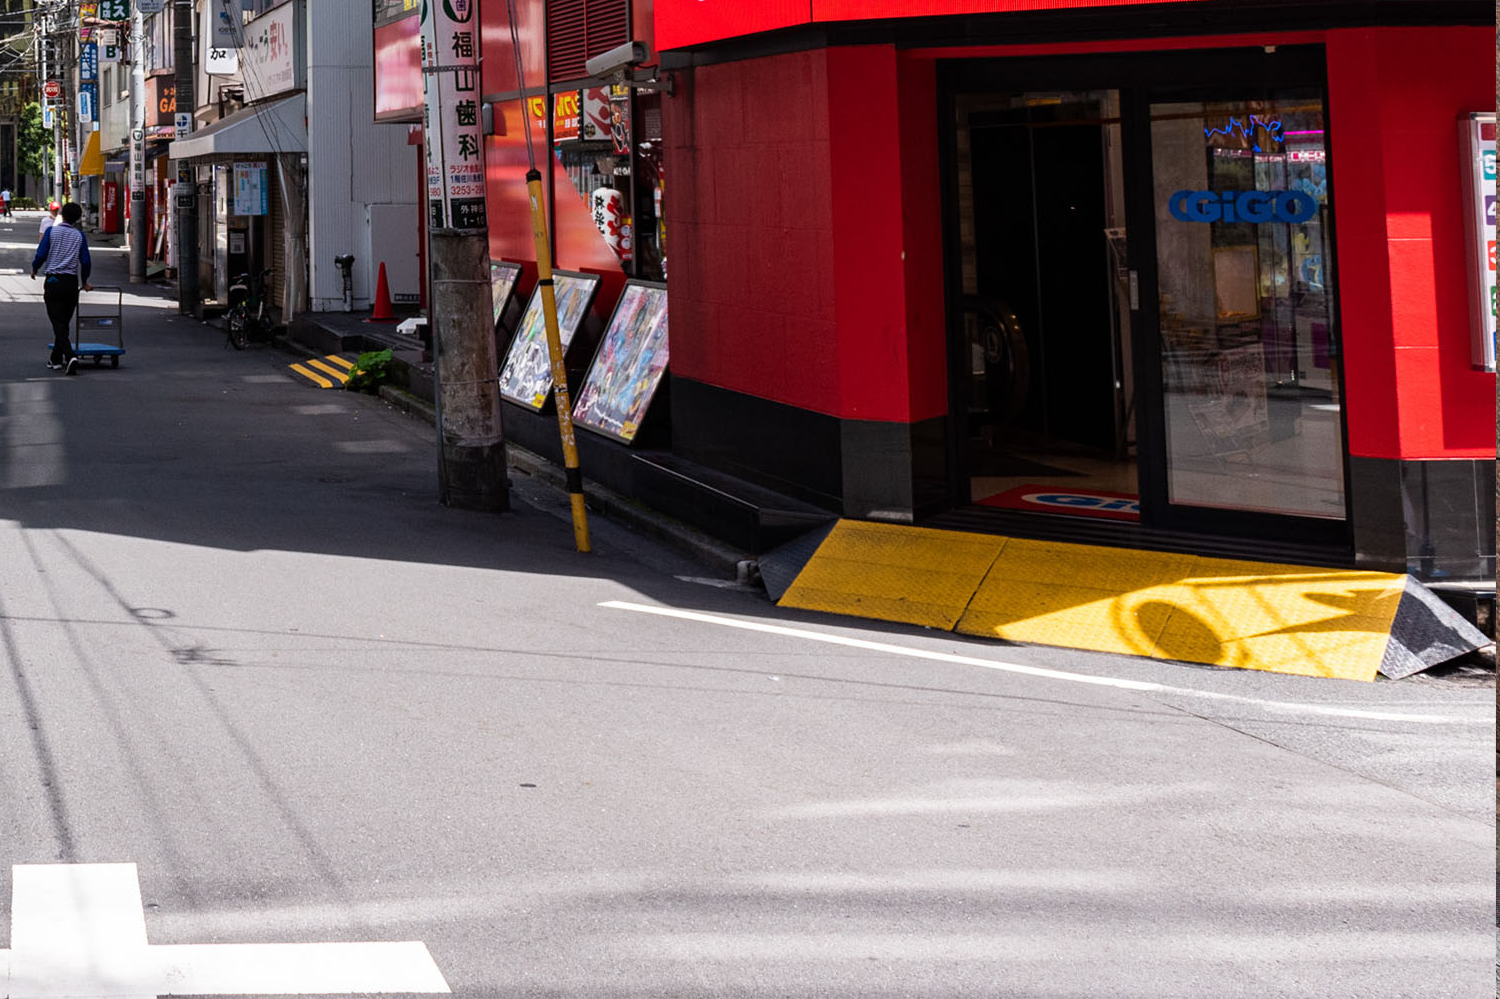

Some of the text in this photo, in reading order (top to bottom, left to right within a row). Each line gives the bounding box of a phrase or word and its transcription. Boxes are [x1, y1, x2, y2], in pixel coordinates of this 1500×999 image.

[451, 31, 480, 162] 福山歯科
[1186, 190, 1316, 224] GiGO
